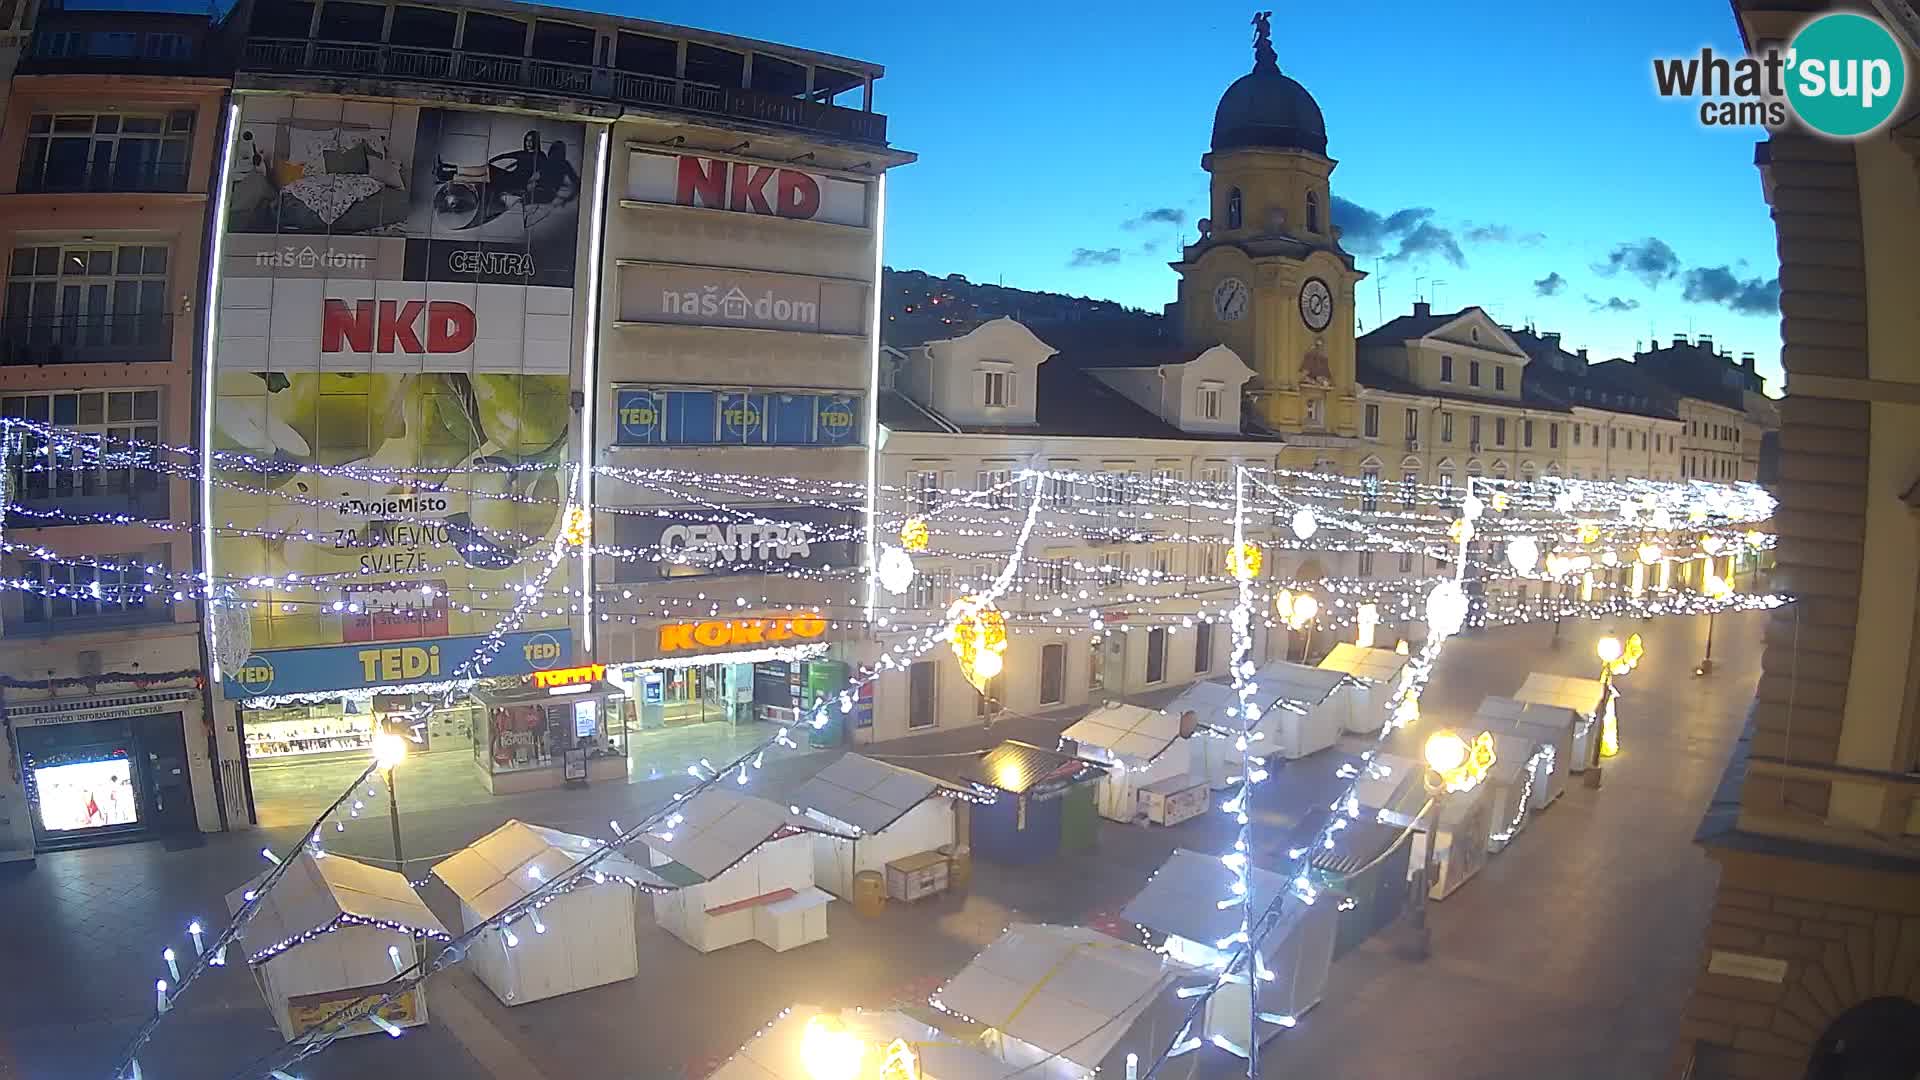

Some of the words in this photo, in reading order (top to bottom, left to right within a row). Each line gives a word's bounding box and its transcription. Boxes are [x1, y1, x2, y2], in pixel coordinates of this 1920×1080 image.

[676, 156, 820, 220] NKD
[255, 246, 296, 268] naš
[320, 248, 368, 270] dom
[447, 249, 537, 277] CENTRA
[662, 285, 719, 316] naš
[755, 291, 816, 323] dom
[322, 298, 477, 355] NKD
[619, 408, 658, 426] TEDi
[723, 409, 760, 426] TEDi
[821, 411, 853, 428] TEDi
[339, 497, 447, 516] #TvojeMisto
[335, 528, 358, 549] ZA
[368, 525, 451, 549] DNEVNO
[660, 522, 811, 564] CENTRA
[360, 546, 428, 574] SVJEŽE
[358, 645, 440, 682] TEDi
[524, 643, 561, 660] TEDi
[238, 666, 275, 684] TEDi
